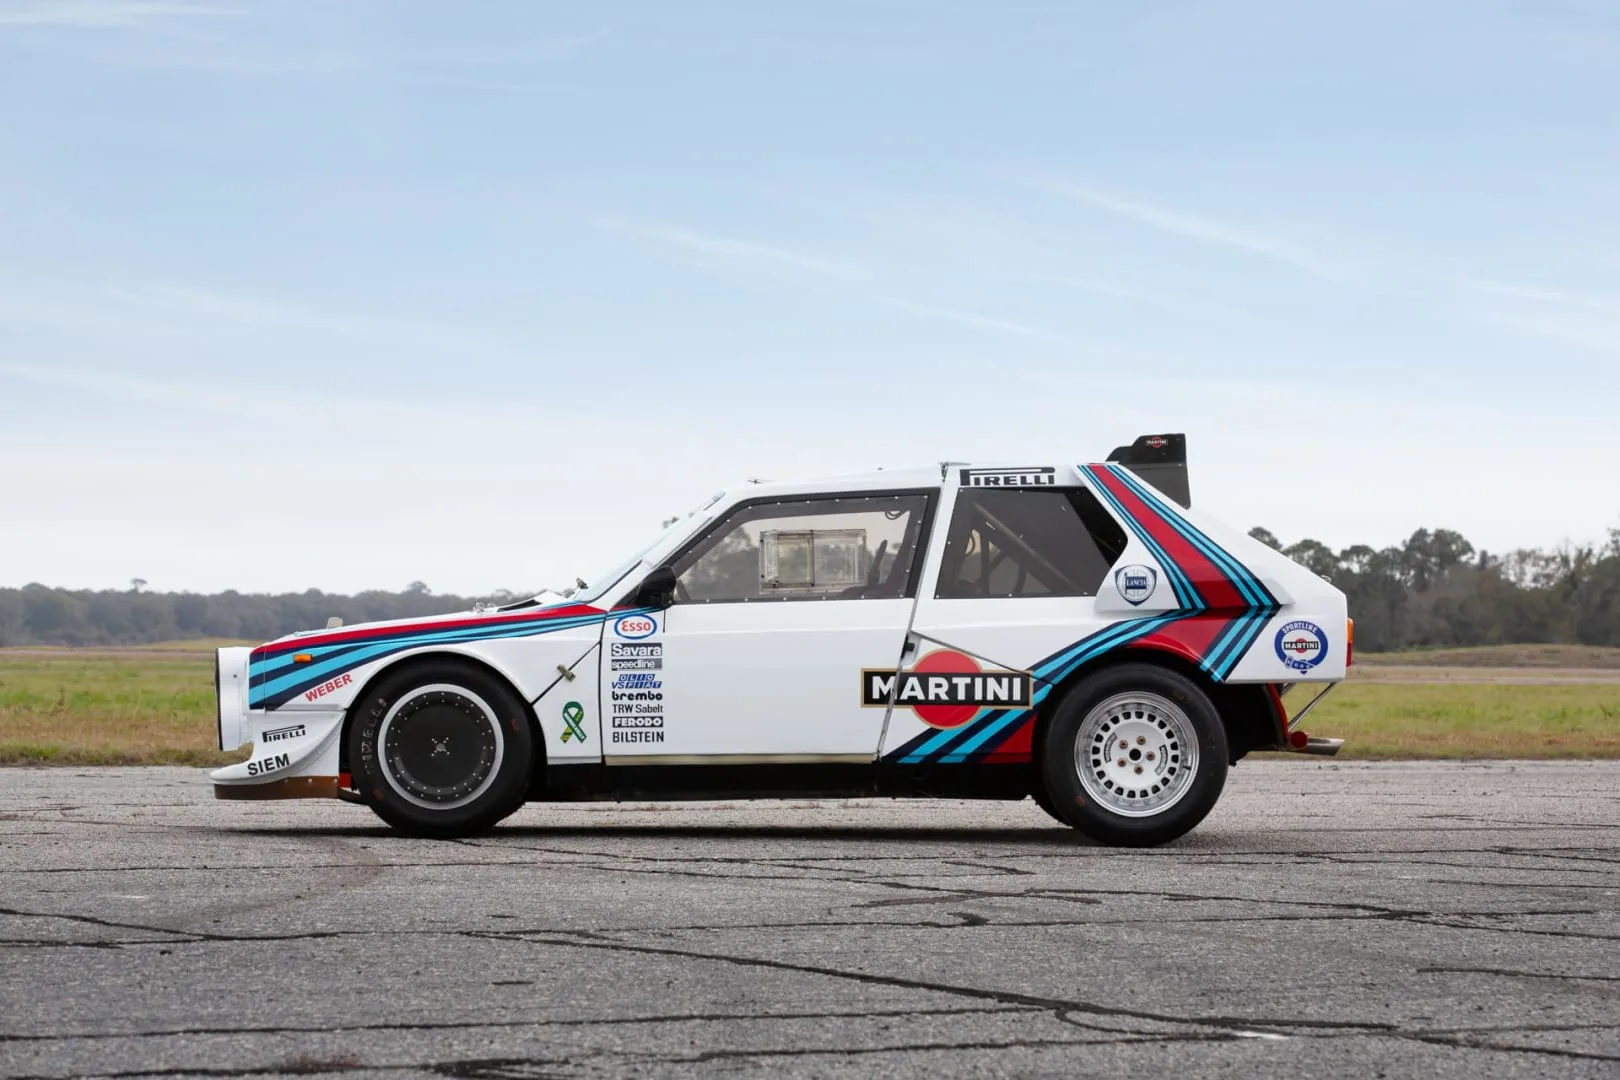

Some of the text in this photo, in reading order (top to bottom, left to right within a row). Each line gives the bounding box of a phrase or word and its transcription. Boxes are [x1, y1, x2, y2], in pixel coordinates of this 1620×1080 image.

[959, 466, 1056, 486] PIRELLI
[612, 643, 662, 656] Savara
[612, 660, 655, 671] speedline
[304, 674, 353, 702] WEBER
[871, 675, 1022, 701] MARTINI
[611, 691, 663, 701] brembo
[612, 704, 663, 713] TRW Sabelt
[614, 718, 662, 727] FERODO
[262, 724, 306, 744] PIRELLI
[612, 731, 664, 743] BILSTEIN
[247, 753, 290, 776] SIEM
